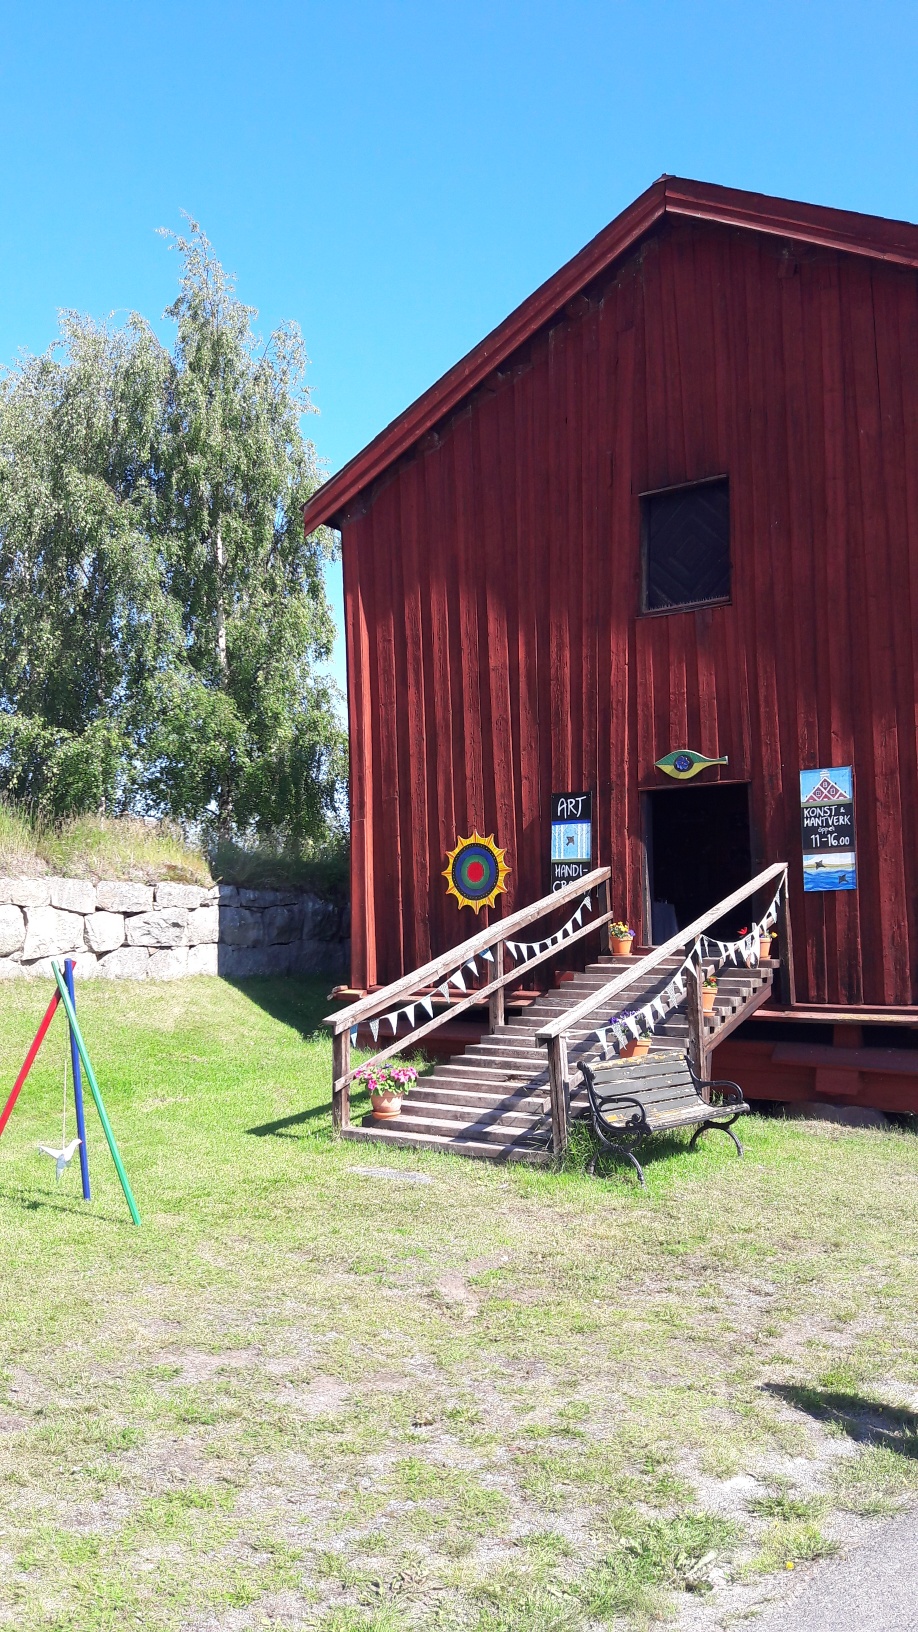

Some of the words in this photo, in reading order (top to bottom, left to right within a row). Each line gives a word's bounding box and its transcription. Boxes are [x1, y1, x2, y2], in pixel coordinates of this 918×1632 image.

[558, 796, 586, 819] ART
[804, 806, 837, 817] KONST
[804, 815, 851, 827] HANTVERK
[555, 864, 588, 878] HANDI-
